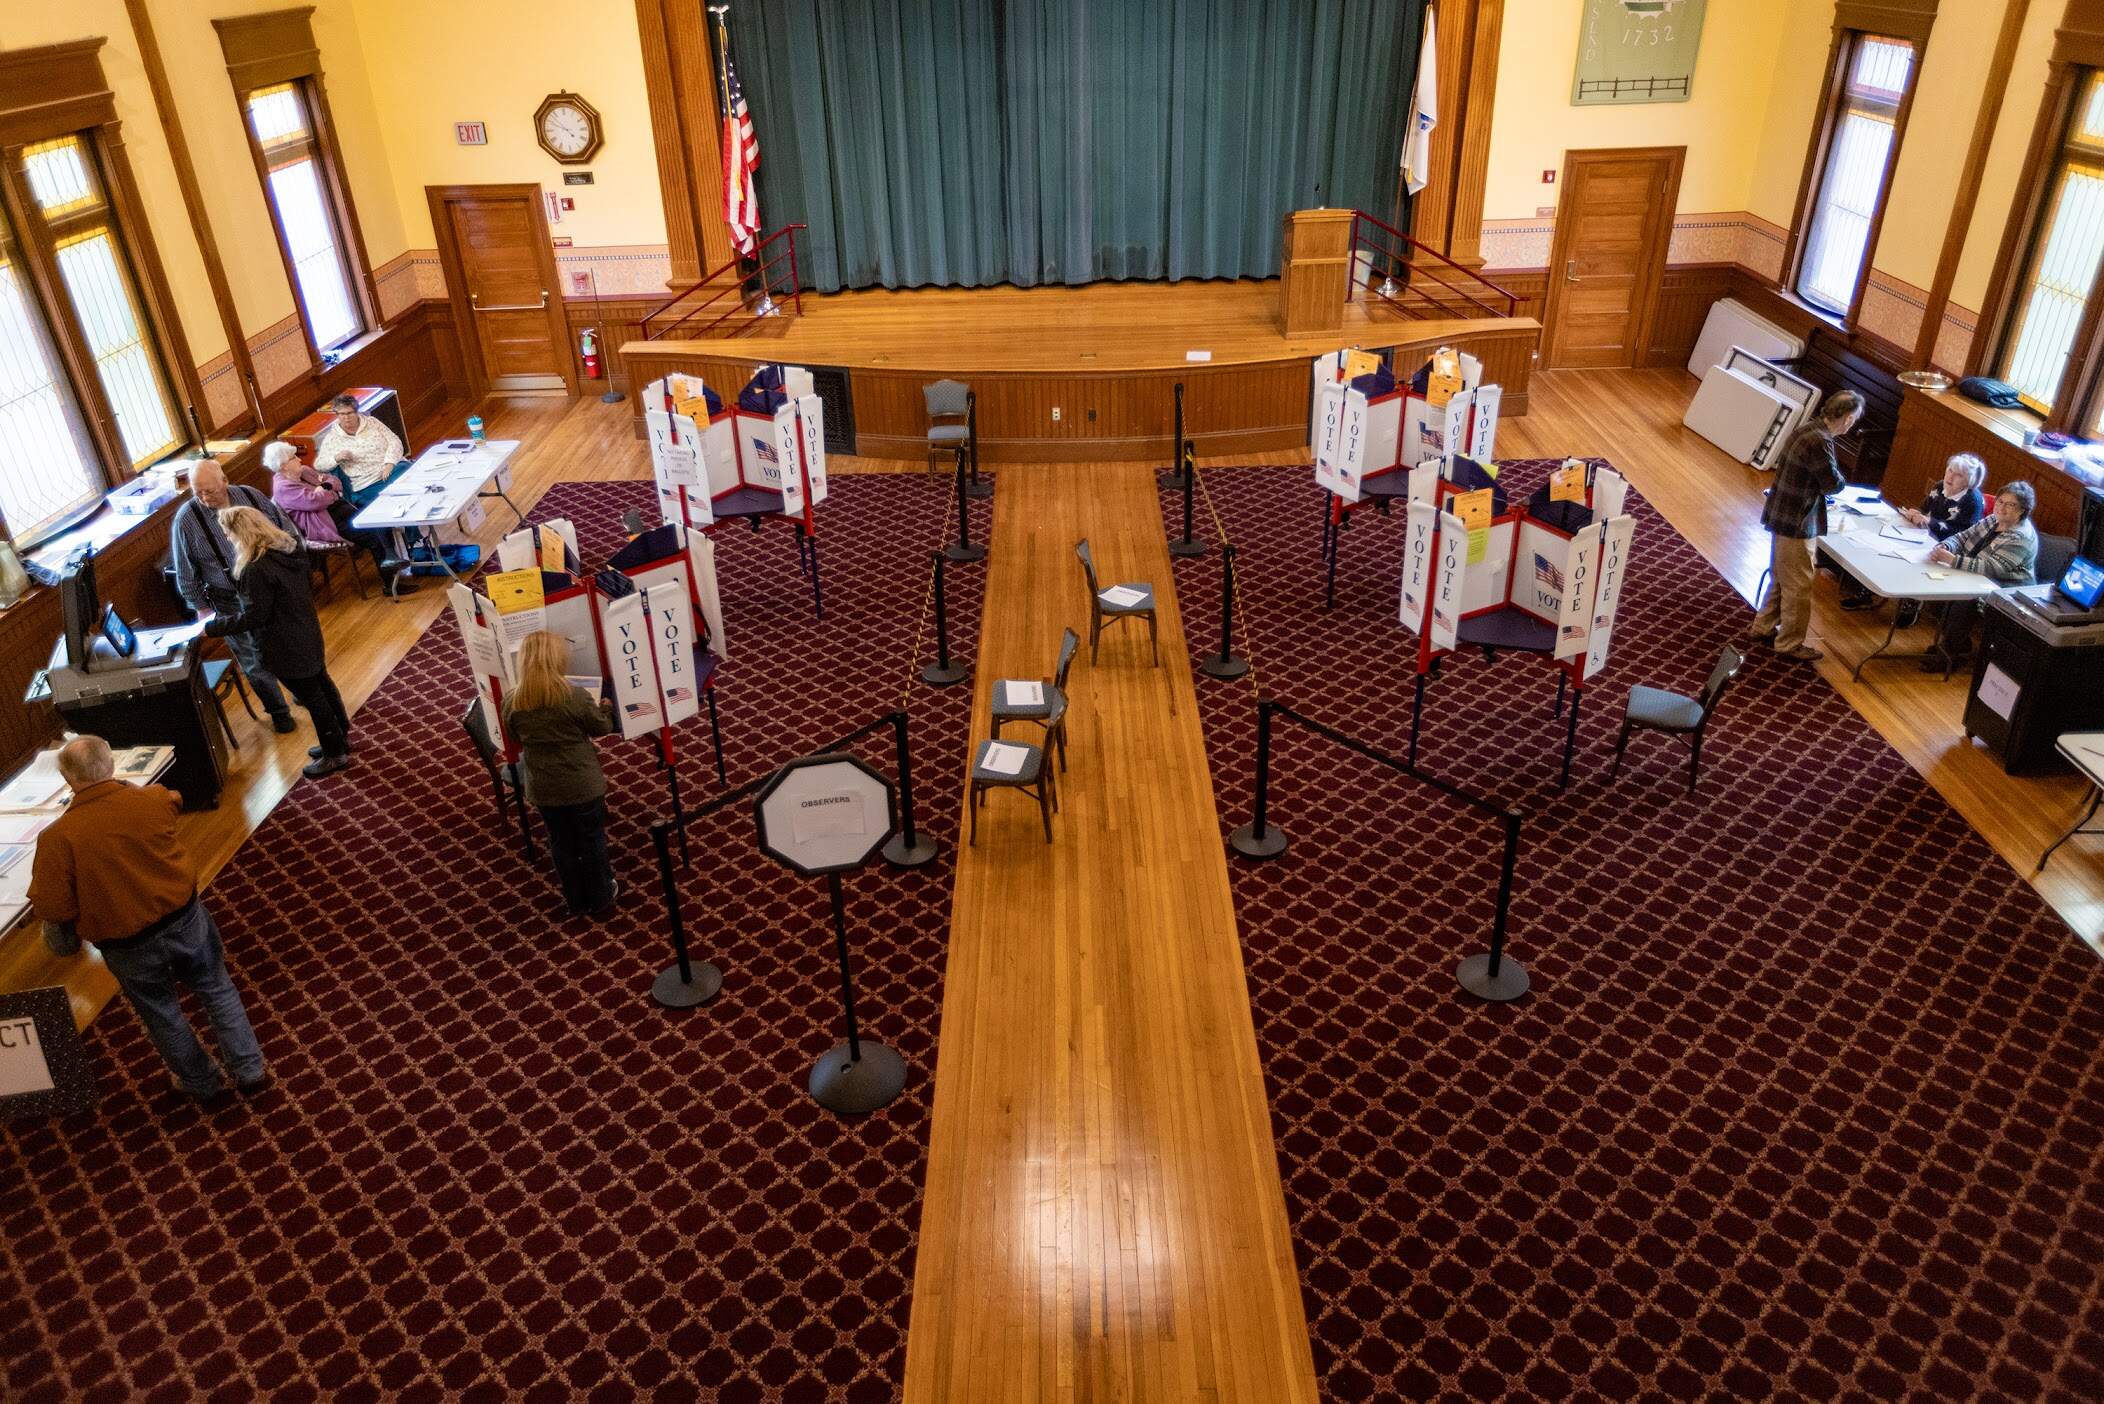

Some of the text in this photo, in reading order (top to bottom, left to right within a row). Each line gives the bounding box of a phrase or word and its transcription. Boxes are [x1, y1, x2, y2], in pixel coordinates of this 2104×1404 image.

[1622, 25, 1675, 47] 1732
[457, 125, 481, 142] EXIT
[783, 423, 797, 475] VOTE
[807, 414, 818, 465] VOTE
[1326, 400, 1336, 452] VOTE
[1348, 411, 1360, 463] VOTE
[1478, 405, 1490, 456] VOTE
[763, 466, 781, 479] VOT
[1413, 524, 1426, 586] VOTE
[1442, 538, 1458, 600] VOTE
[1572, 550, 1587, 612] VOTE
[1603, 538, 1620, 601] VOTE
[1537, 590, 1561, 610] VOT
[618, 622, 642, 689] VOTE
[663, 607, 682, 674] VOTE
[801, 796, 850, 808] OBSERVERS
